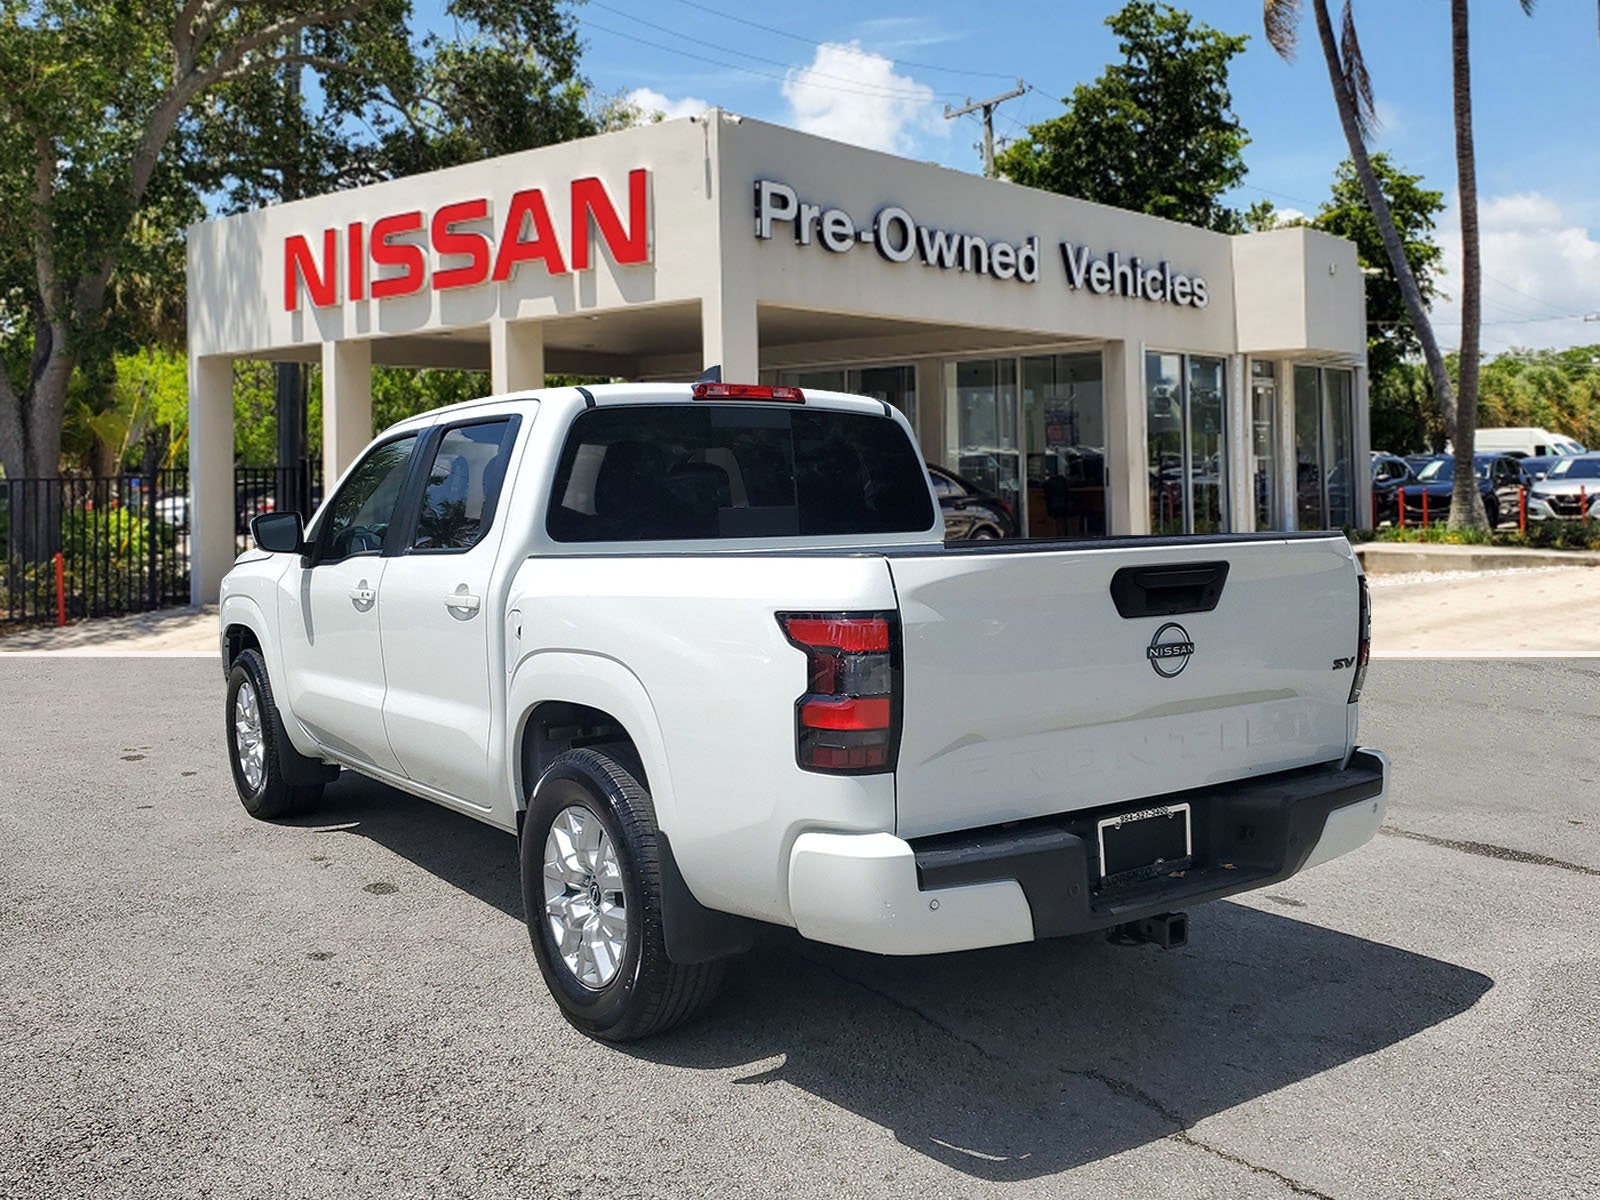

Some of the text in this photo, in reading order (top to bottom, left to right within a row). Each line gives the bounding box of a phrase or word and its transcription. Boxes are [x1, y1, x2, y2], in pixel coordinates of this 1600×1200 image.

[284, 168, 650, 312] NISSAN
[754, 179, 1209, 308] Pre-Owned Vehicles
[1149, 644, 1194, 657] NISSAN
[1332, 656, 1356, 671] SV
